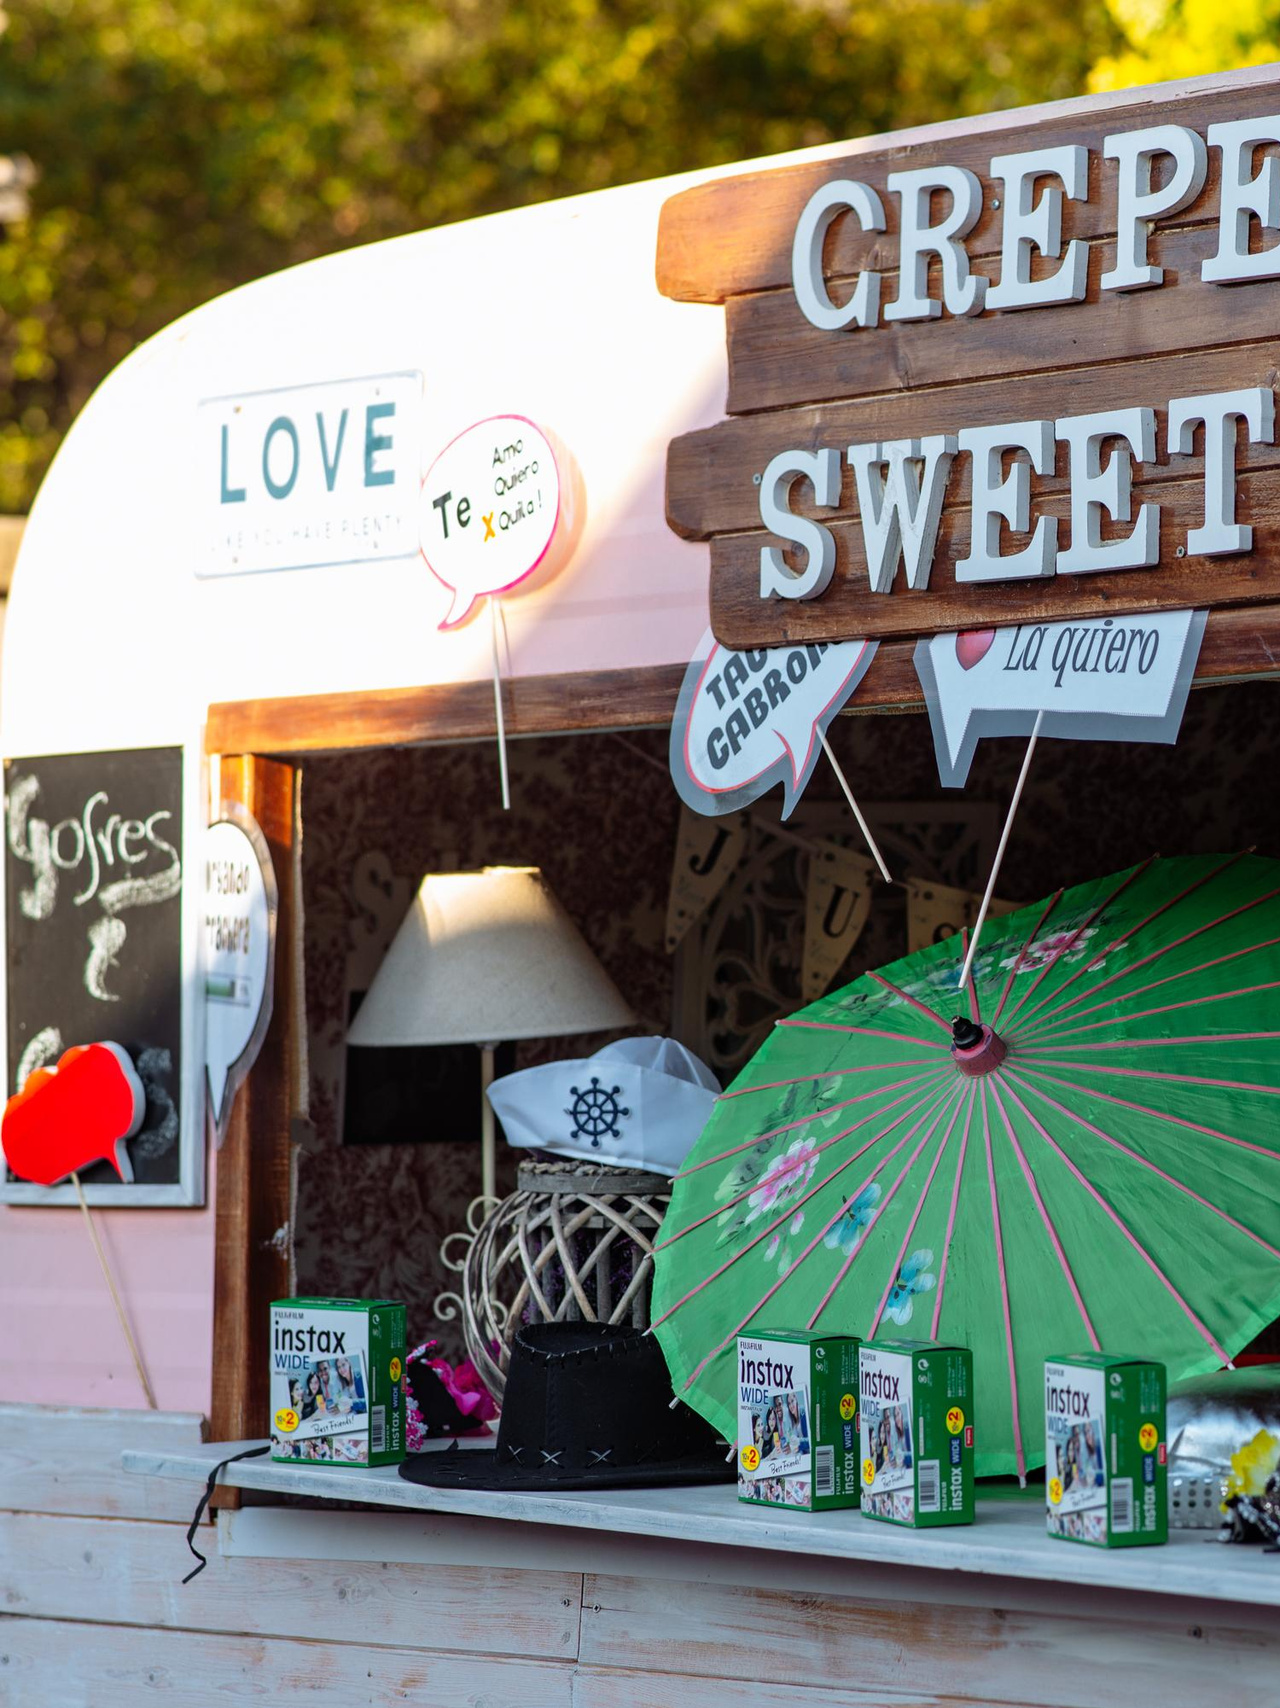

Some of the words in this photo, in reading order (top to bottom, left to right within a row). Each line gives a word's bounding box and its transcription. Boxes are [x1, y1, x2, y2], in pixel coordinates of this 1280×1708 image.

[220, 402, 396, 504] LOVE
[492, 439, 523, 469] Amo
[494, 460, 539, 496] Quiero
[759, 386, 1275, 601] SWEET
[432, 491, 471, 539] Te
[1002, 623, 1050, 671] La
[1051, 619, 1160, 688] quiero
[705, 645, 780, 710] TAC
[274, 1320, 346, 1355] instax
[740, 1341, 763, 1351] FUJIFILM
[274, 1354, 310, 1370] WIDE
[740, 1350, 794, 1390] instax
[860, 1362, 900, 1401] instax
[740, 1386, 769, 1405] WIDE
[861, 1399, 880, 1417] WIDE
[1046, 1377, 1091, 1418] instax
[390, 1411, 400, 1451] instax
[844, 1424, 852, 1449] WIDE
[951, 1438, 960, 1463] WIDE
[842, 1452, 855, 1495] instax
[949, 1467, 962, 1511] instax
